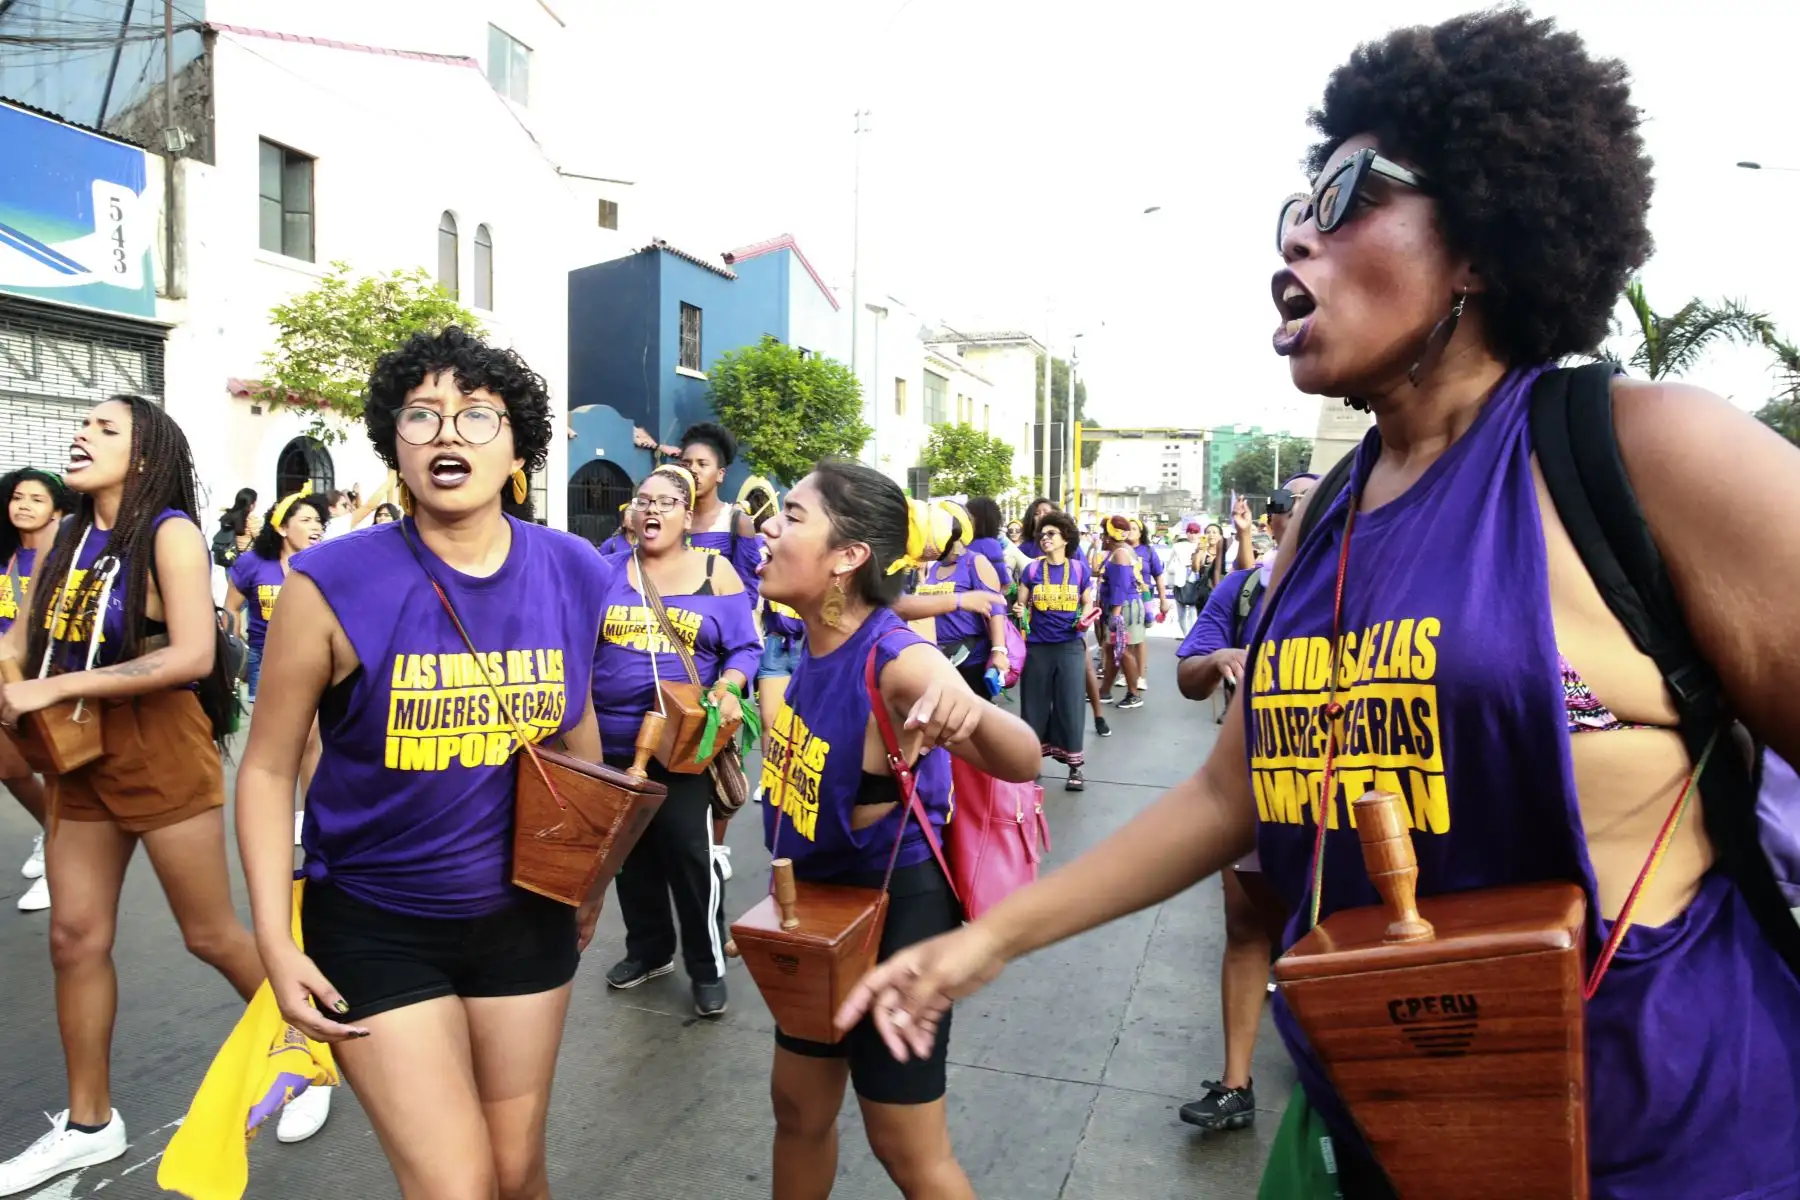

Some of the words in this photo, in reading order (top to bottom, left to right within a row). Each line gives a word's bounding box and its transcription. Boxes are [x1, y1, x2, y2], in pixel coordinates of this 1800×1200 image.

[109, 196, 127, 274] 543
[391, 653, 438, 690] LAS
[439, 651, 506, 688] VIDAS
[506, 650, 537, 684] DE
[536, 649, 564, 683] LAS
[1250, 639, 1276, 692] AS
[1374, 617, 1441, 680] LAS
[393, 693, 490, 730] MUJERES
[497, 690, 563, 725] NEGRAS
[1334, 697, 1434, 760] EGRAS
[384, 729, 545, 771] IMPOR
